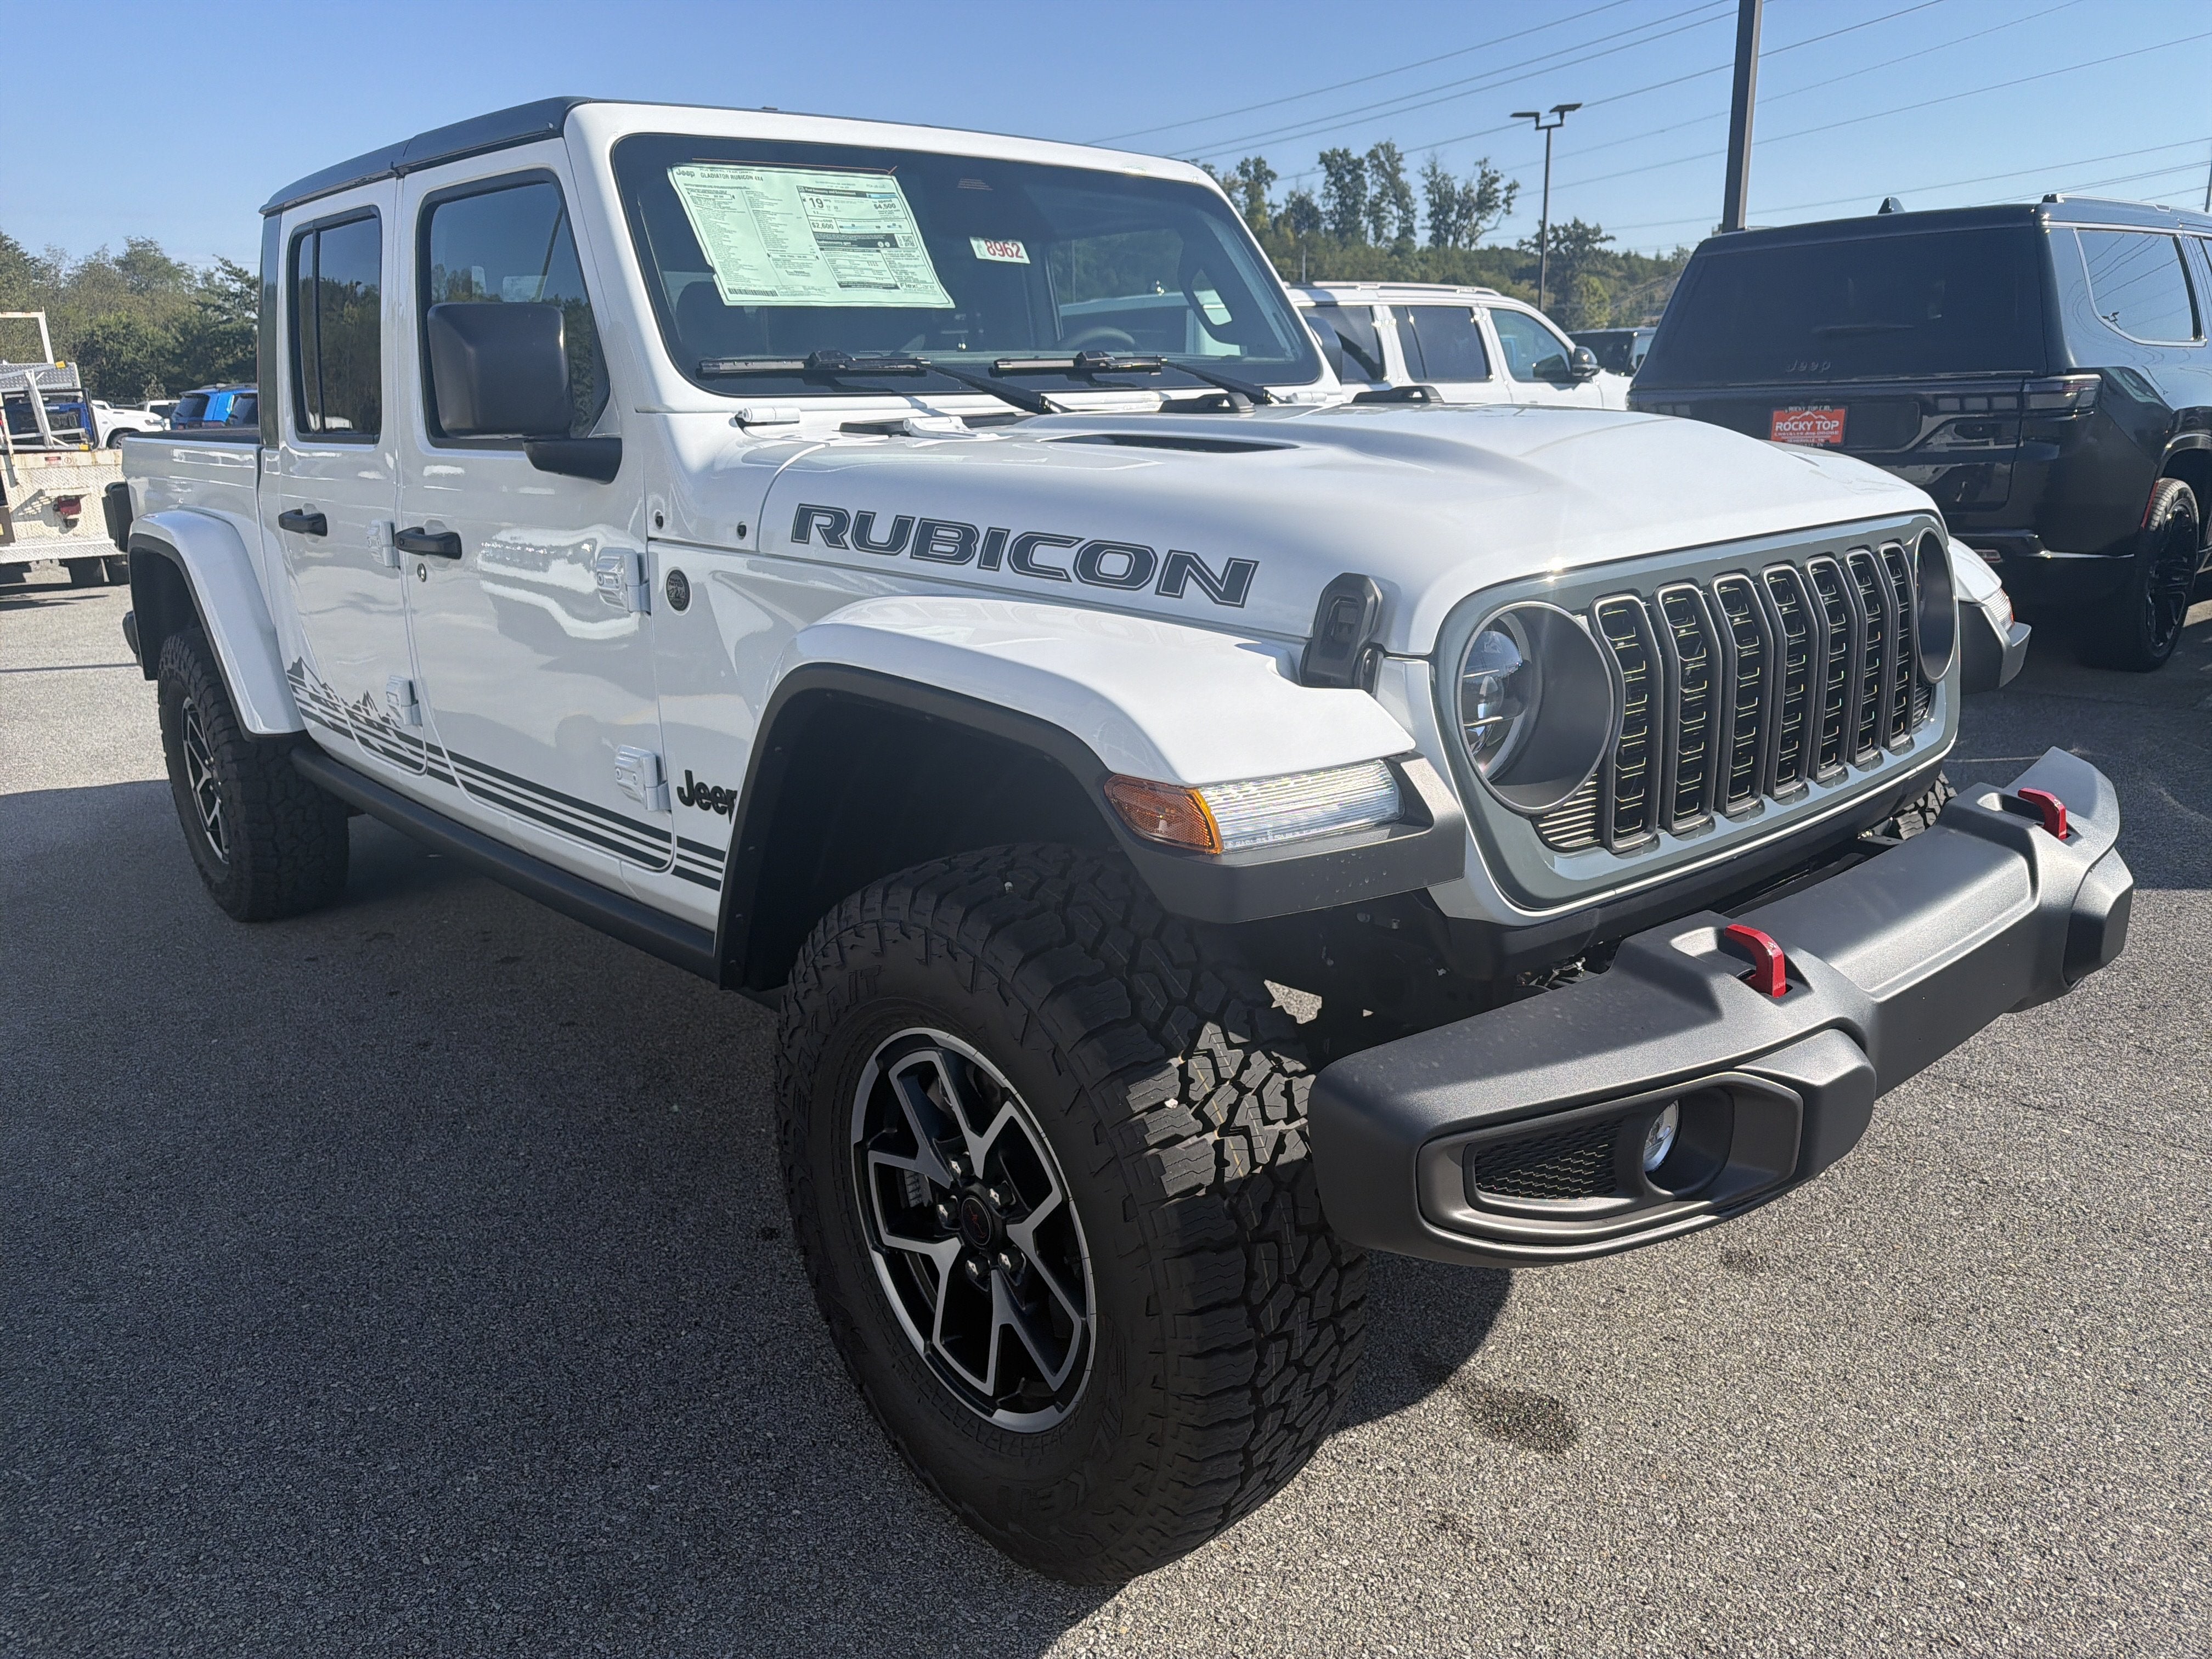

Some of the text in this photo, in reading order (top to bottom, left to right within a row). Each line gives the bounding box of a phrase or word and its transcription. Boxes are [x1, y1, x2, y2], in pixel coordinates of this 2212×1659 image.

[676, 168, 695, 178] Jeep
[700, 172, 730, 180] GLADIATOR
[809, 198, 823, 208] 19
[984, 240, 1024, 259] 8962
[1786, 359, 1831, 373] Jeep
[1775, 420, 1839, 432] ROCKY TOP
[790, 503, 1259, 608] RUBICON
